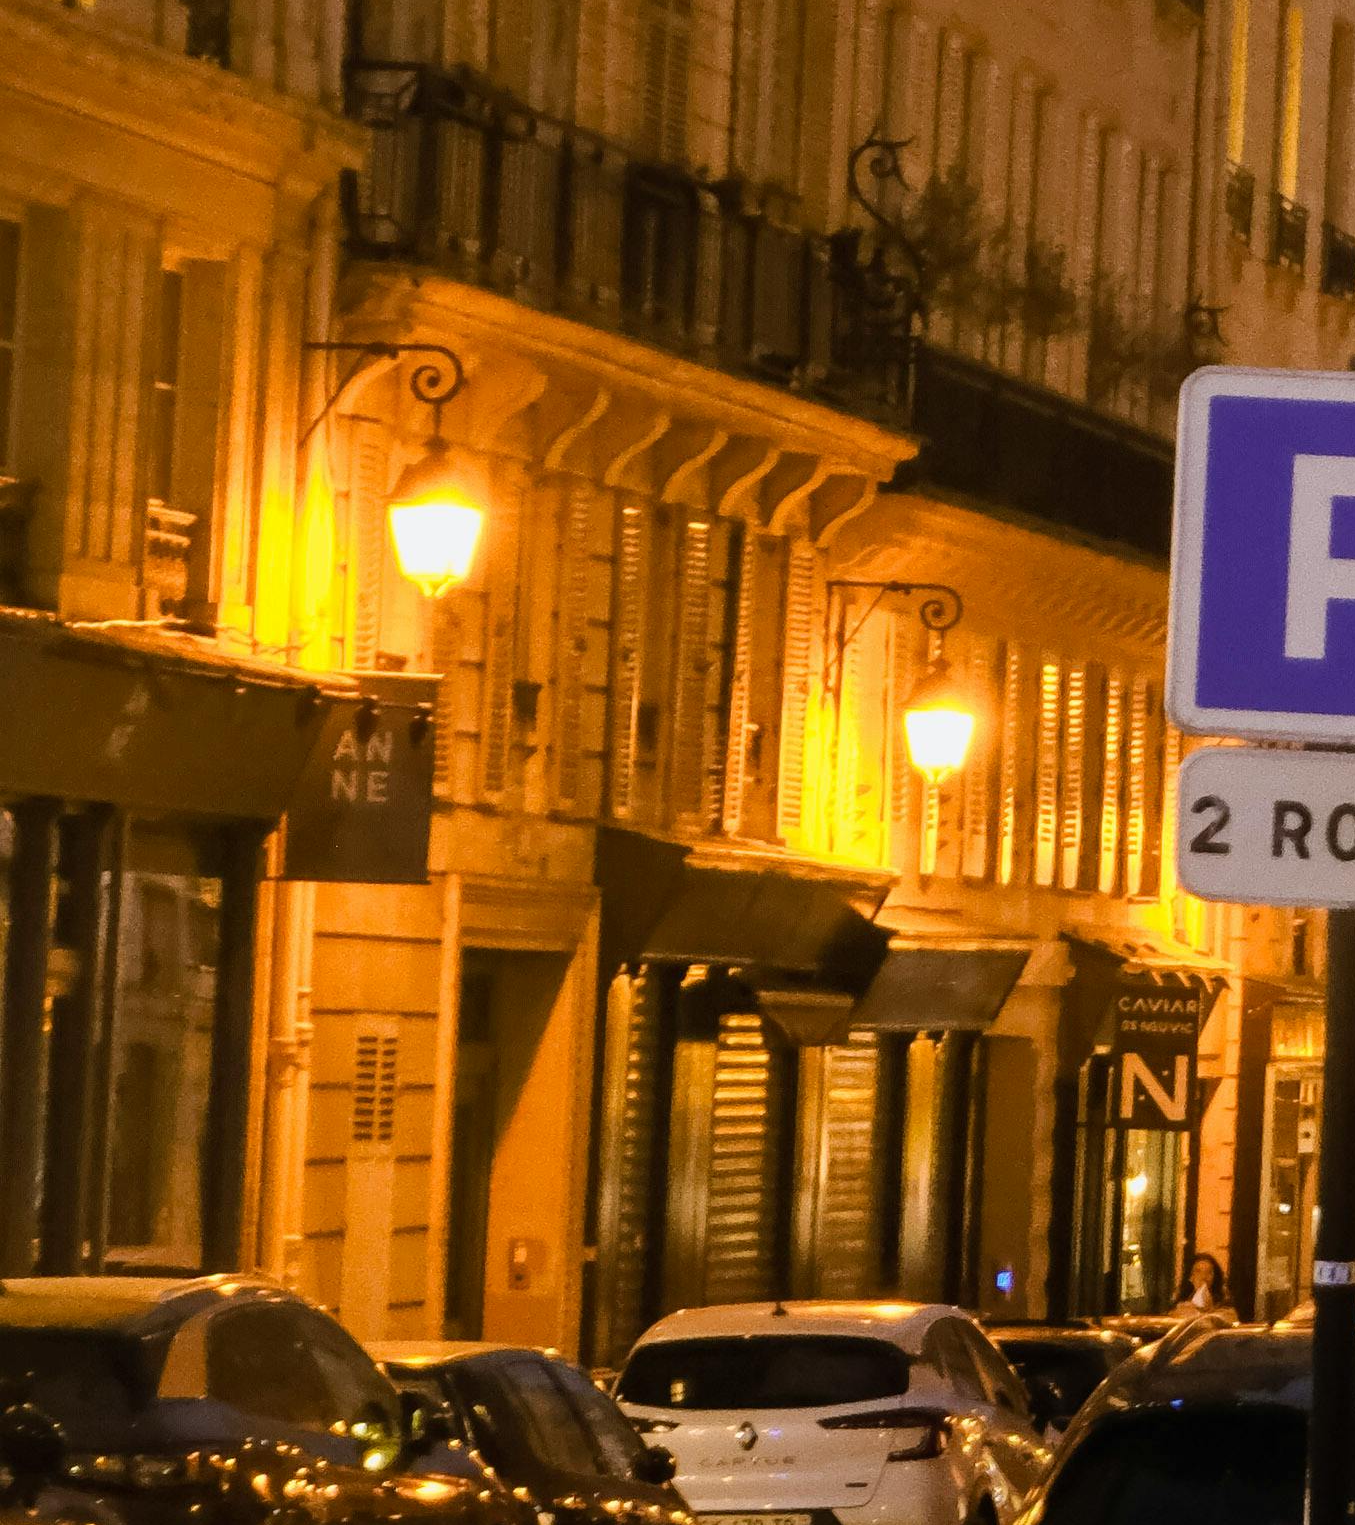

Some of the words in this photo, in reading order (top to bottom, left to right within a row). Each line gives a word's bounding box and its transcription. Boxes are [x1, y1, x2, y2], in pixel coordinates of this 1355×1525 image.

[332, 730, 393, 762] AN
[331, 769, 390, 803] NE
[1189, 795, 1230, 855] 2
[1118, 996, 1198, 1013] CAVIAR
[1119, 1052, 1189, 1121] N
